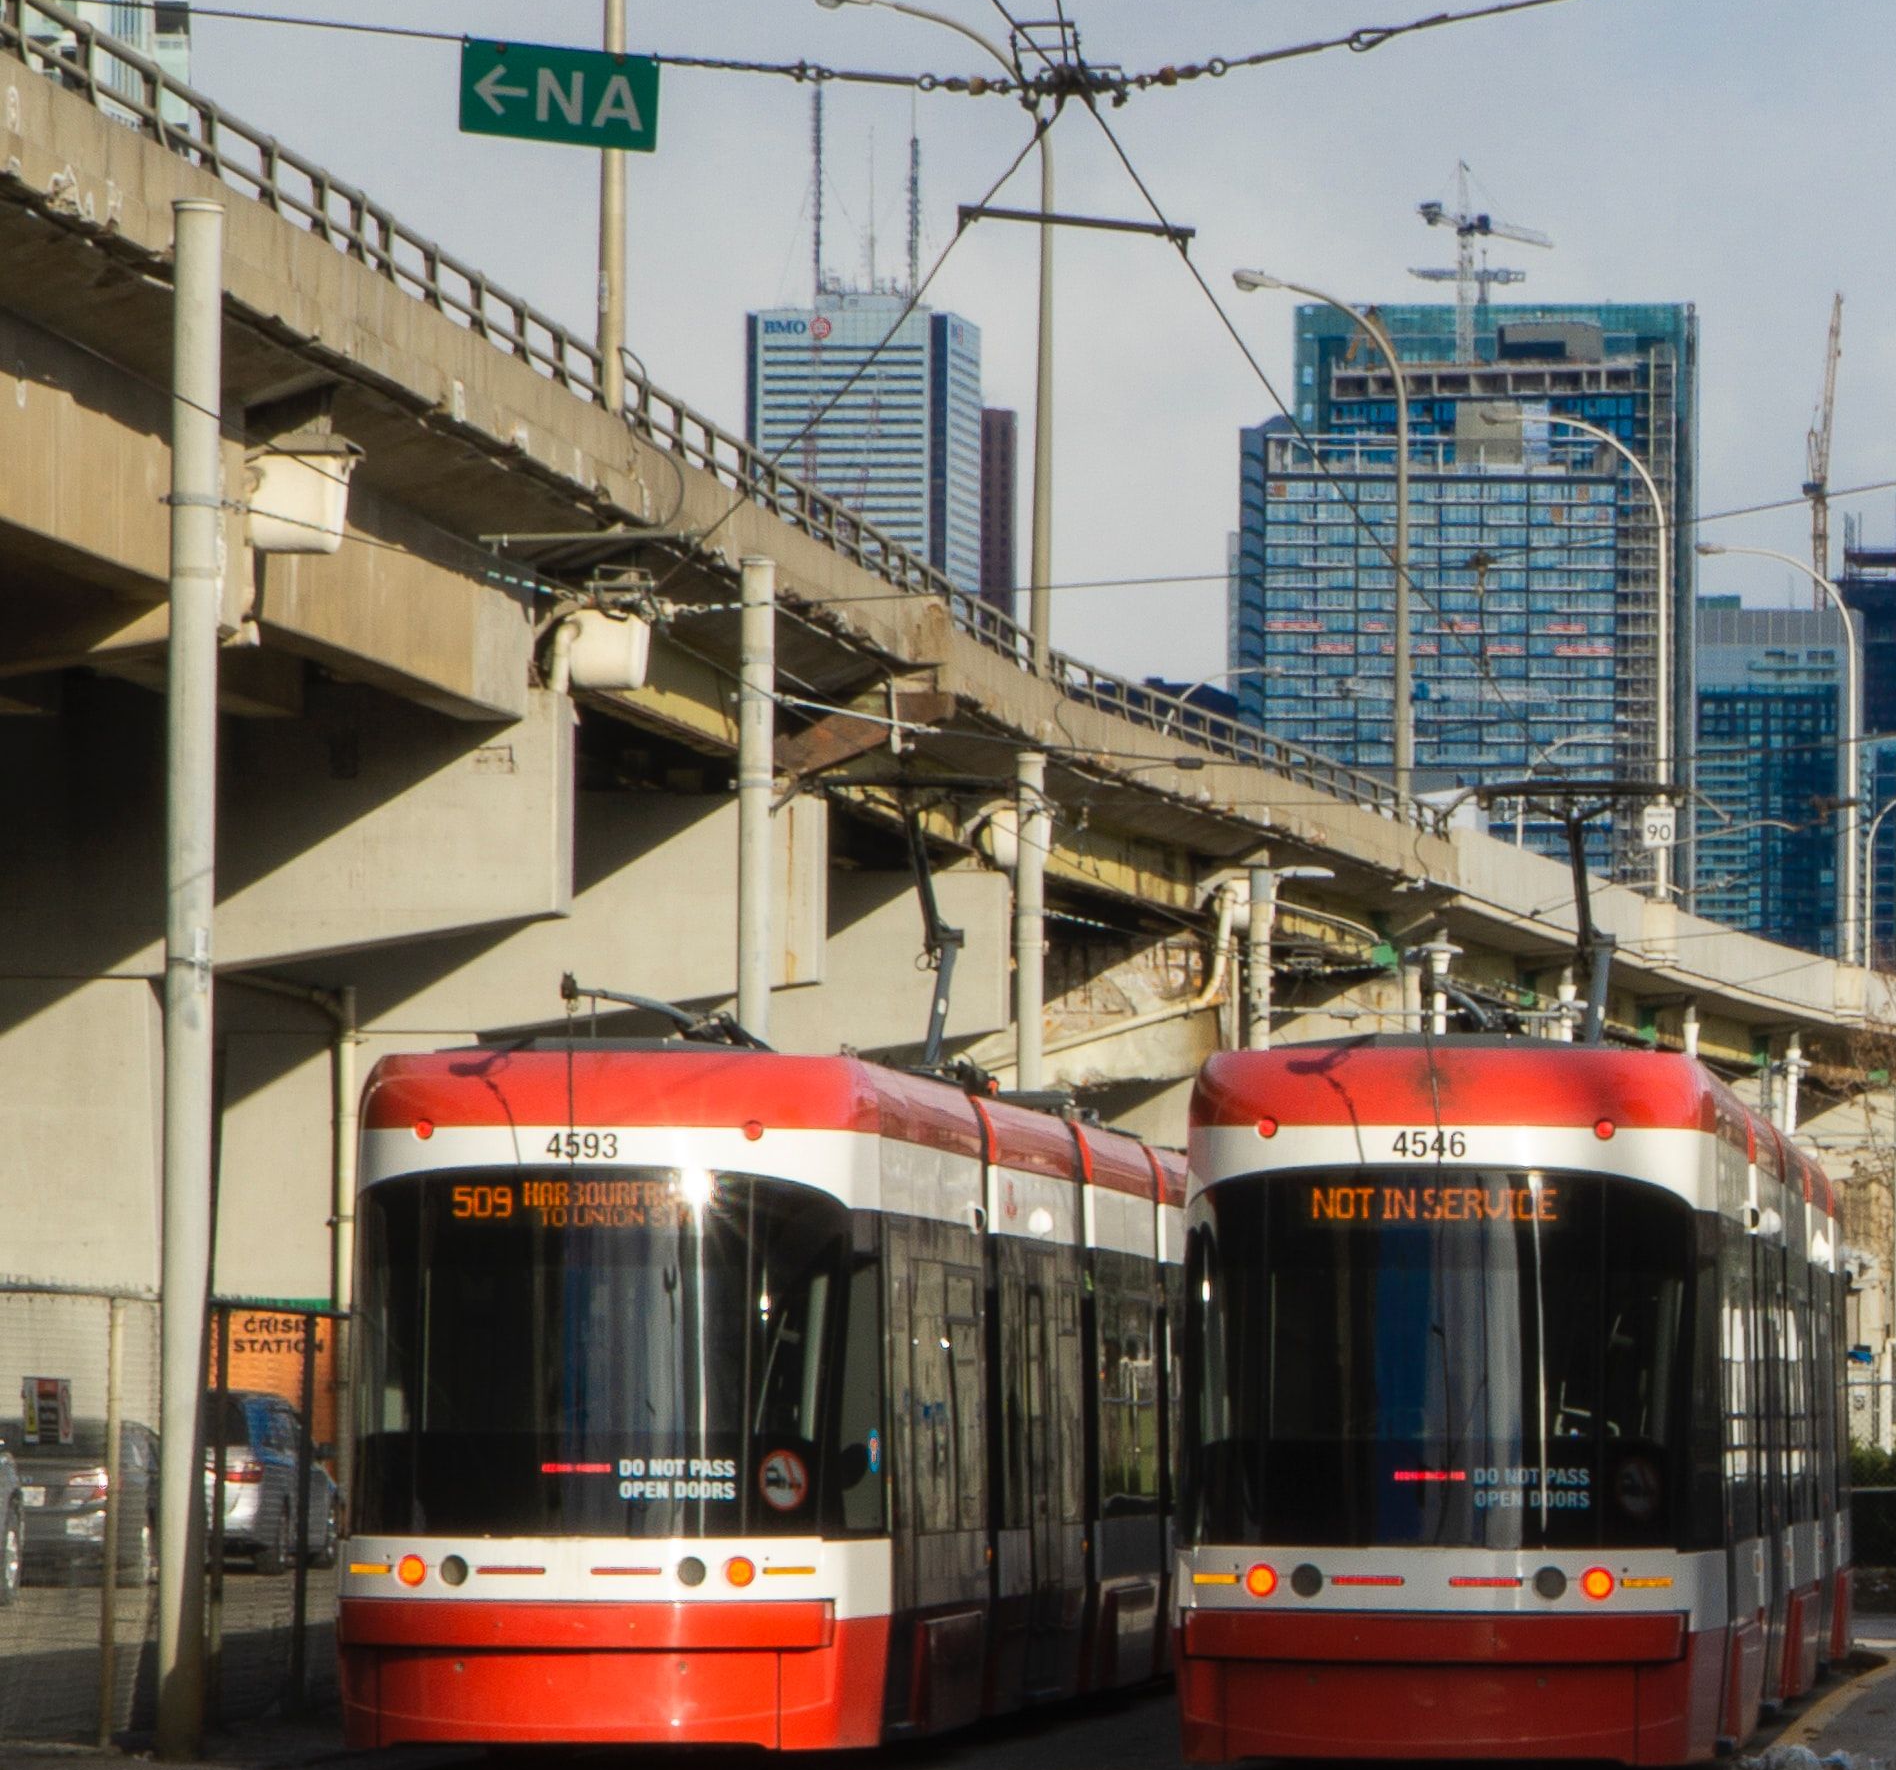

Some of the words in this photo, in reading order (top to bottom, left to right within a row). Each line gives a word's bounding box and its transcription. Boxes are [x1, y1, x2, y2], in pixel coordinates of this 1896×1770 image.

[536, 67, 644, 131] NA
[764, 320, 807, 335] BMO
[1648, 824, 1670, 840] 90
[546, 1132, 618, 1160] 4593
[1393, 1130, 1466, 1158] 4546
[453, 1186, 512, 1218] 509
[1312, 1187, 1375, 1220] NOT
[1382, 1187, 1416, 1220] IN
[1422, 1187, 1558, 1221] SERVICE
[541, 1206, 567, 1227] TO
[573, 1206, 645, 1228] UNION
[244, 1318, 319, 1333] CRISI
[619, 1459, 645, 1478] DO
[650, 1459, 685, 1478] NOT
[690, 1459, 736, 1478] PASS
[1474, 1468, 1498, 1486] DO
[1504, 1468, 1540, 1486] NOT
[1547, 1468, 1590, 1486] PASS
[619, 1482, 669, 1500] OPEN
[674, 1482, 736, 1500] DOORS
[1474, 1491, 1523, 1509] OPEN
[1530, 1491, 1590, 1509] DOORS
